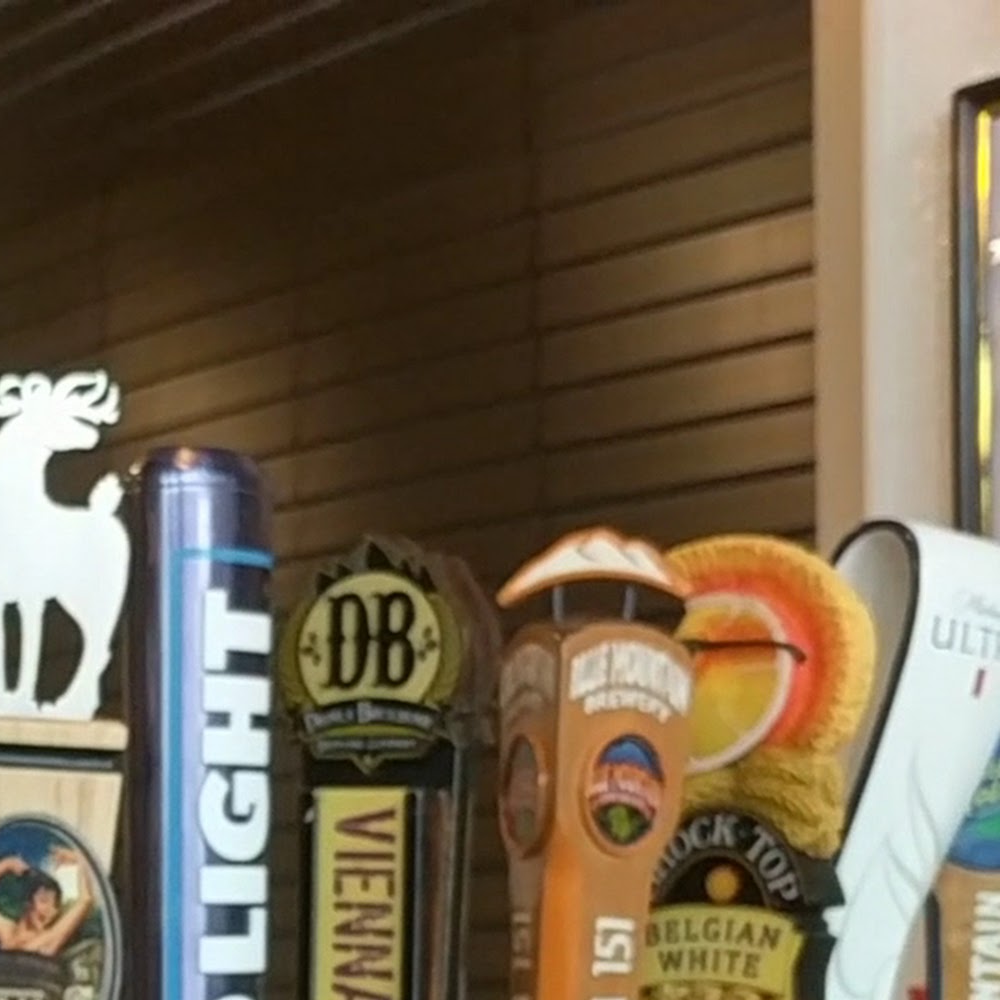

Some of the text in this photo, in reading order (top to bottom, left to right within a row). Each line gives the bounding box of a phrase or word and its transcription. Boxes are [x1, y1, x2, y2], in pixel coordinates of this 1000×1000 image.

[320, 591, 416, 690] DB
[198, 587, 273, 974] LIGHT
[747, 825, 799, 901] TOP
[591, 915, 636, 978] 151
[645, 917, 782, 950] BELGIAN
[657, 950, 762, 979] WHITE
